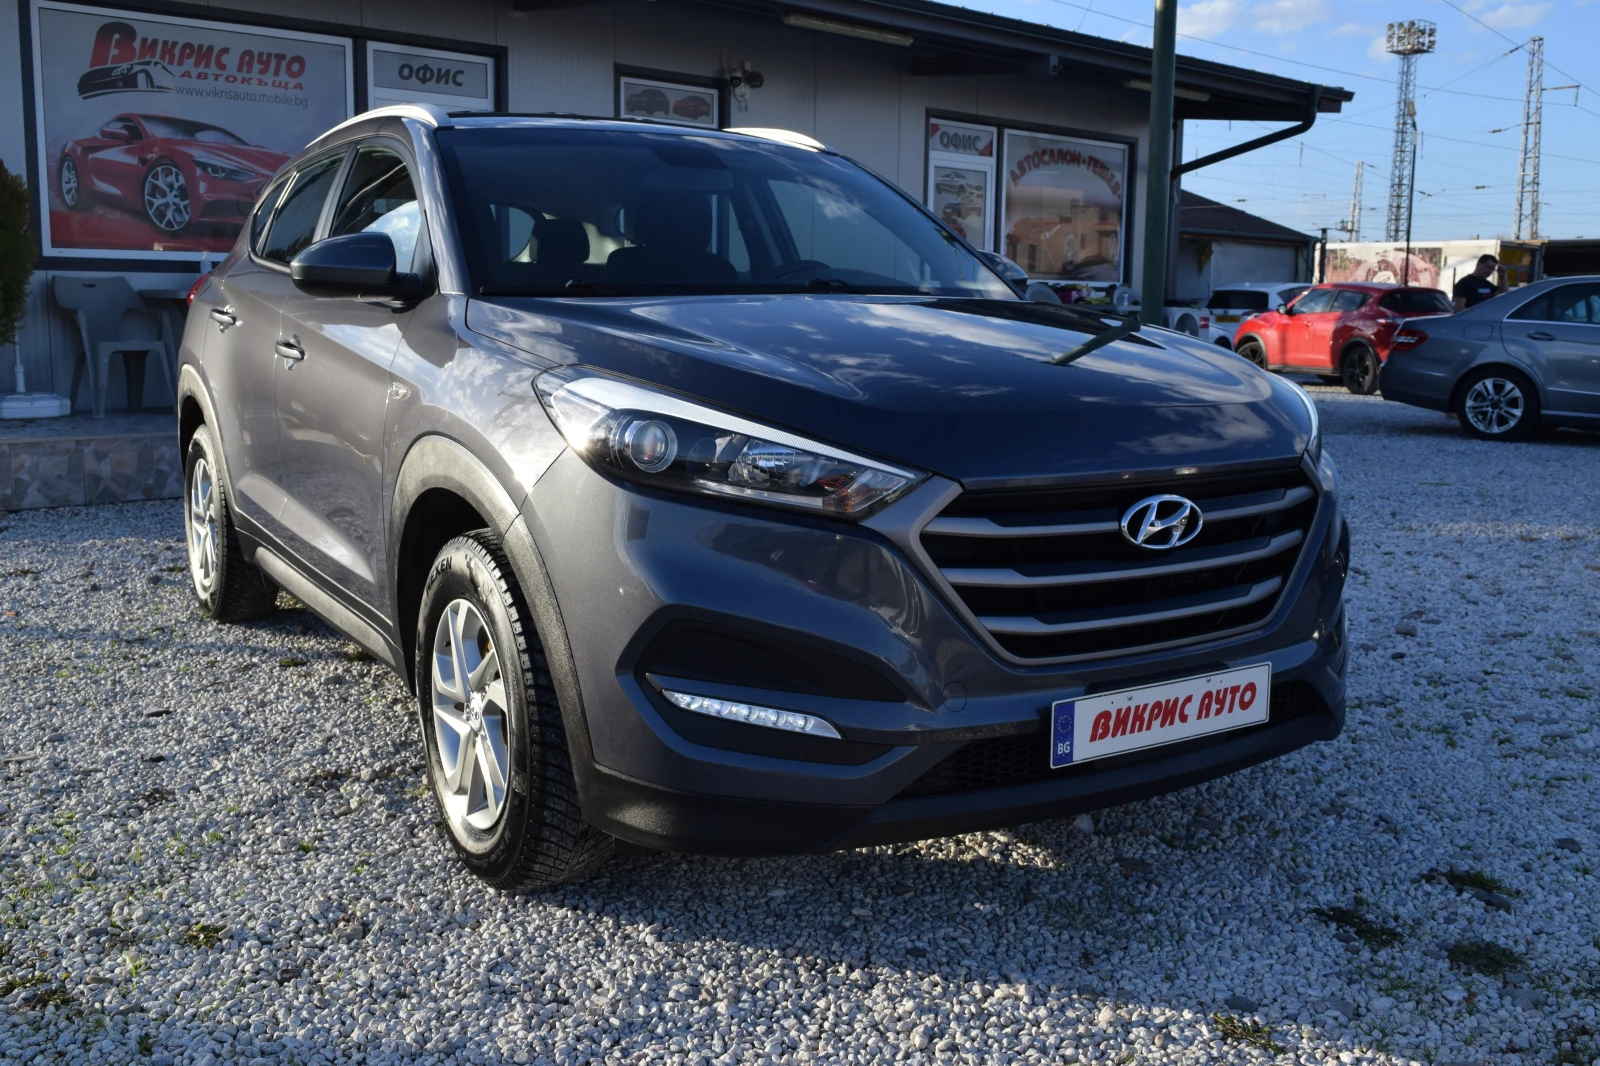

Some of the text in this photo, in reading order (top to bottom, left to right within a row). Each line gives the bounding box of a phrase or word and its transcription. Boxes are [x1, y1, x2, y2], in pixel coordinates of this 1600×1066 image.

[236, 49, 307, 79] АУТО
[398, 62, 465, 88] ОФИС
[179, 70, 304, 90] АВТОКЪЩА
[174, 85, 308, 109] www.vikrisauto.mobile.bg
[939, 130, 982, 153] ОФИС
[1089, 681, 1257, 743] ВИКРИС АУТО
[1057, 742, 1071, 755] BG
